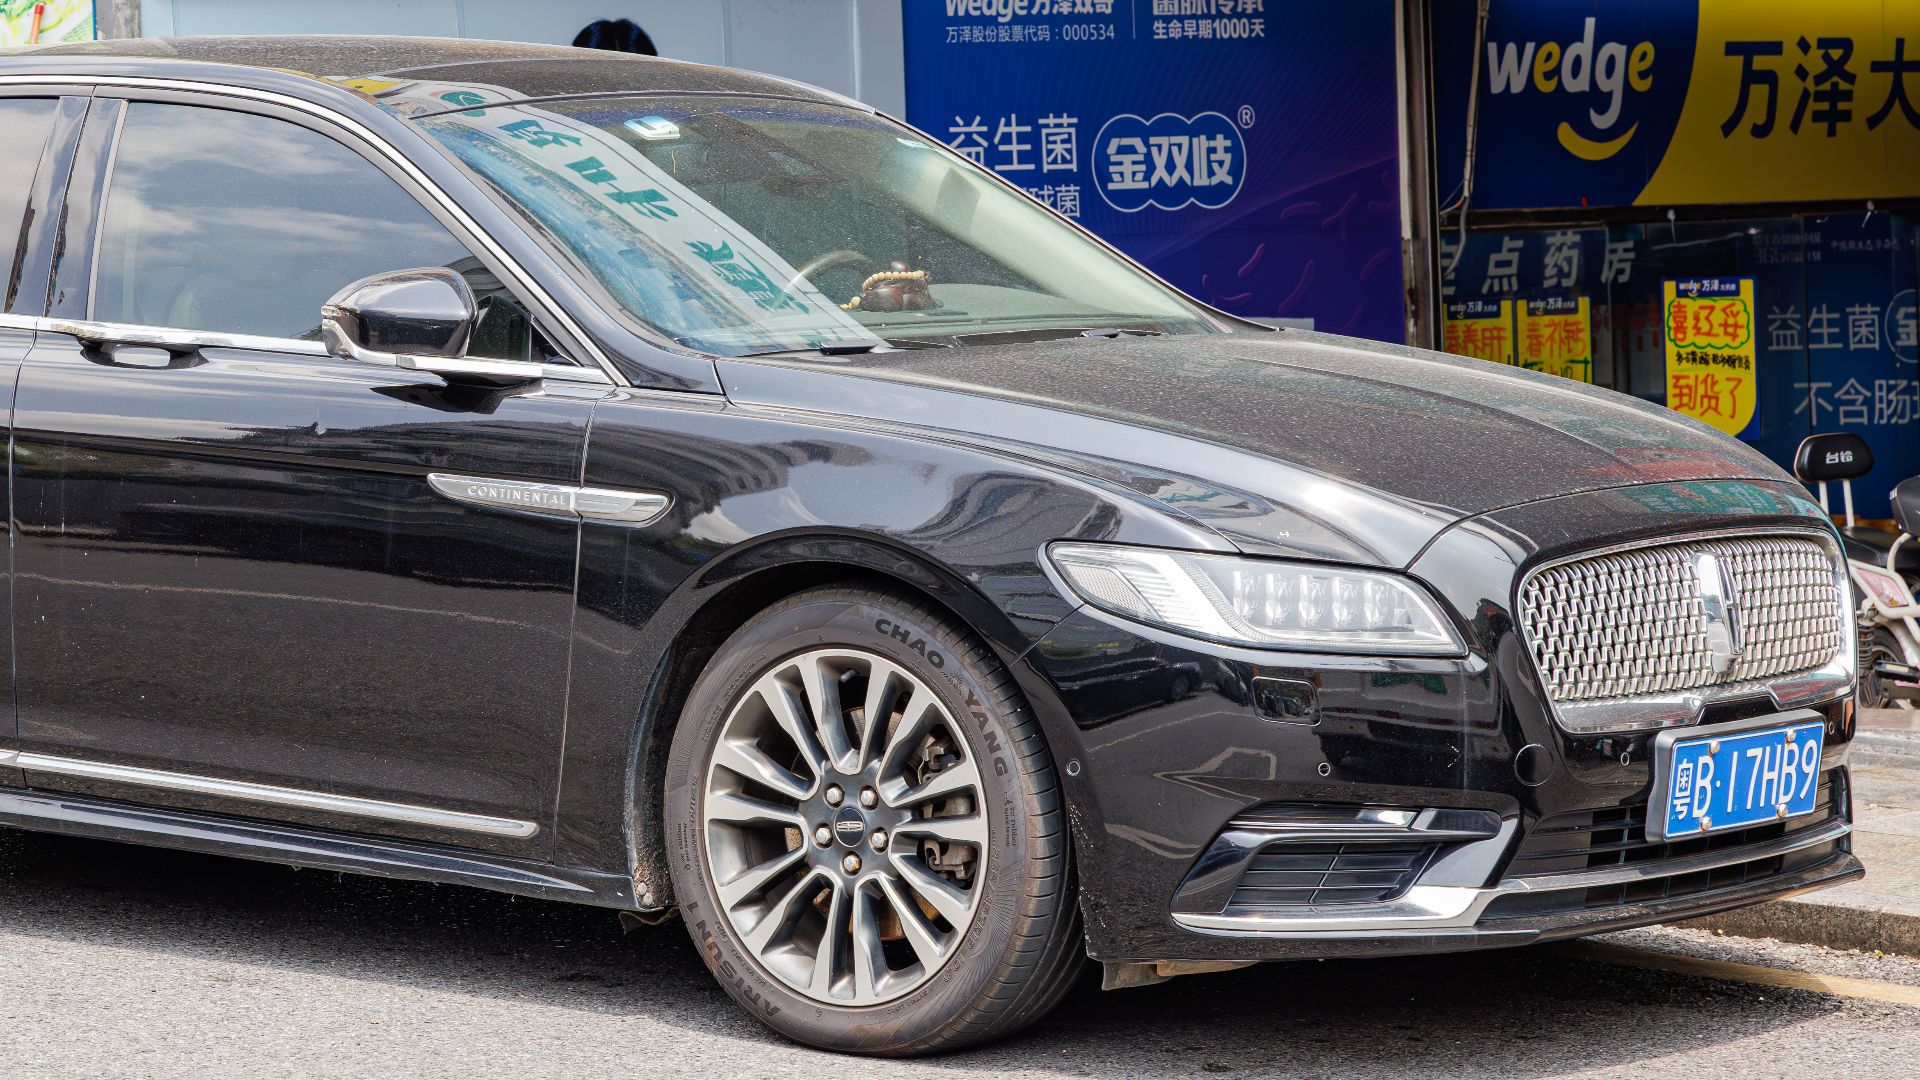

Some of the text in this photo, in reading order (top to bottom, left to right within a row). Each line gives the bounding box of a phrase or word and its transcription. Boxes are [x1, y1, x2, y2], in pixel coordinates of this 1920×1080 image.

[1153, 18, 1265, 39] 生命早期1000天
[1487, 17, 1655, 129] wedge
[949, 113, 1079, 173] 益生菌
[1107, 134, 1233, 190] 金双歧
[1768, 304, 1880, 351] 益生菌
[1672, 373, 1743, 419] 到货了
[1793, 377, 1920, 426] 不含肠
[1826, 450, 1853, 465] 台铃
[467, 485, 567, 505] CONTINENTAL
[875, 618, 945, 669] CHAO
[965, 688, 1008, 777] YANG
[696, 919, 782, 1018] ARISUN
